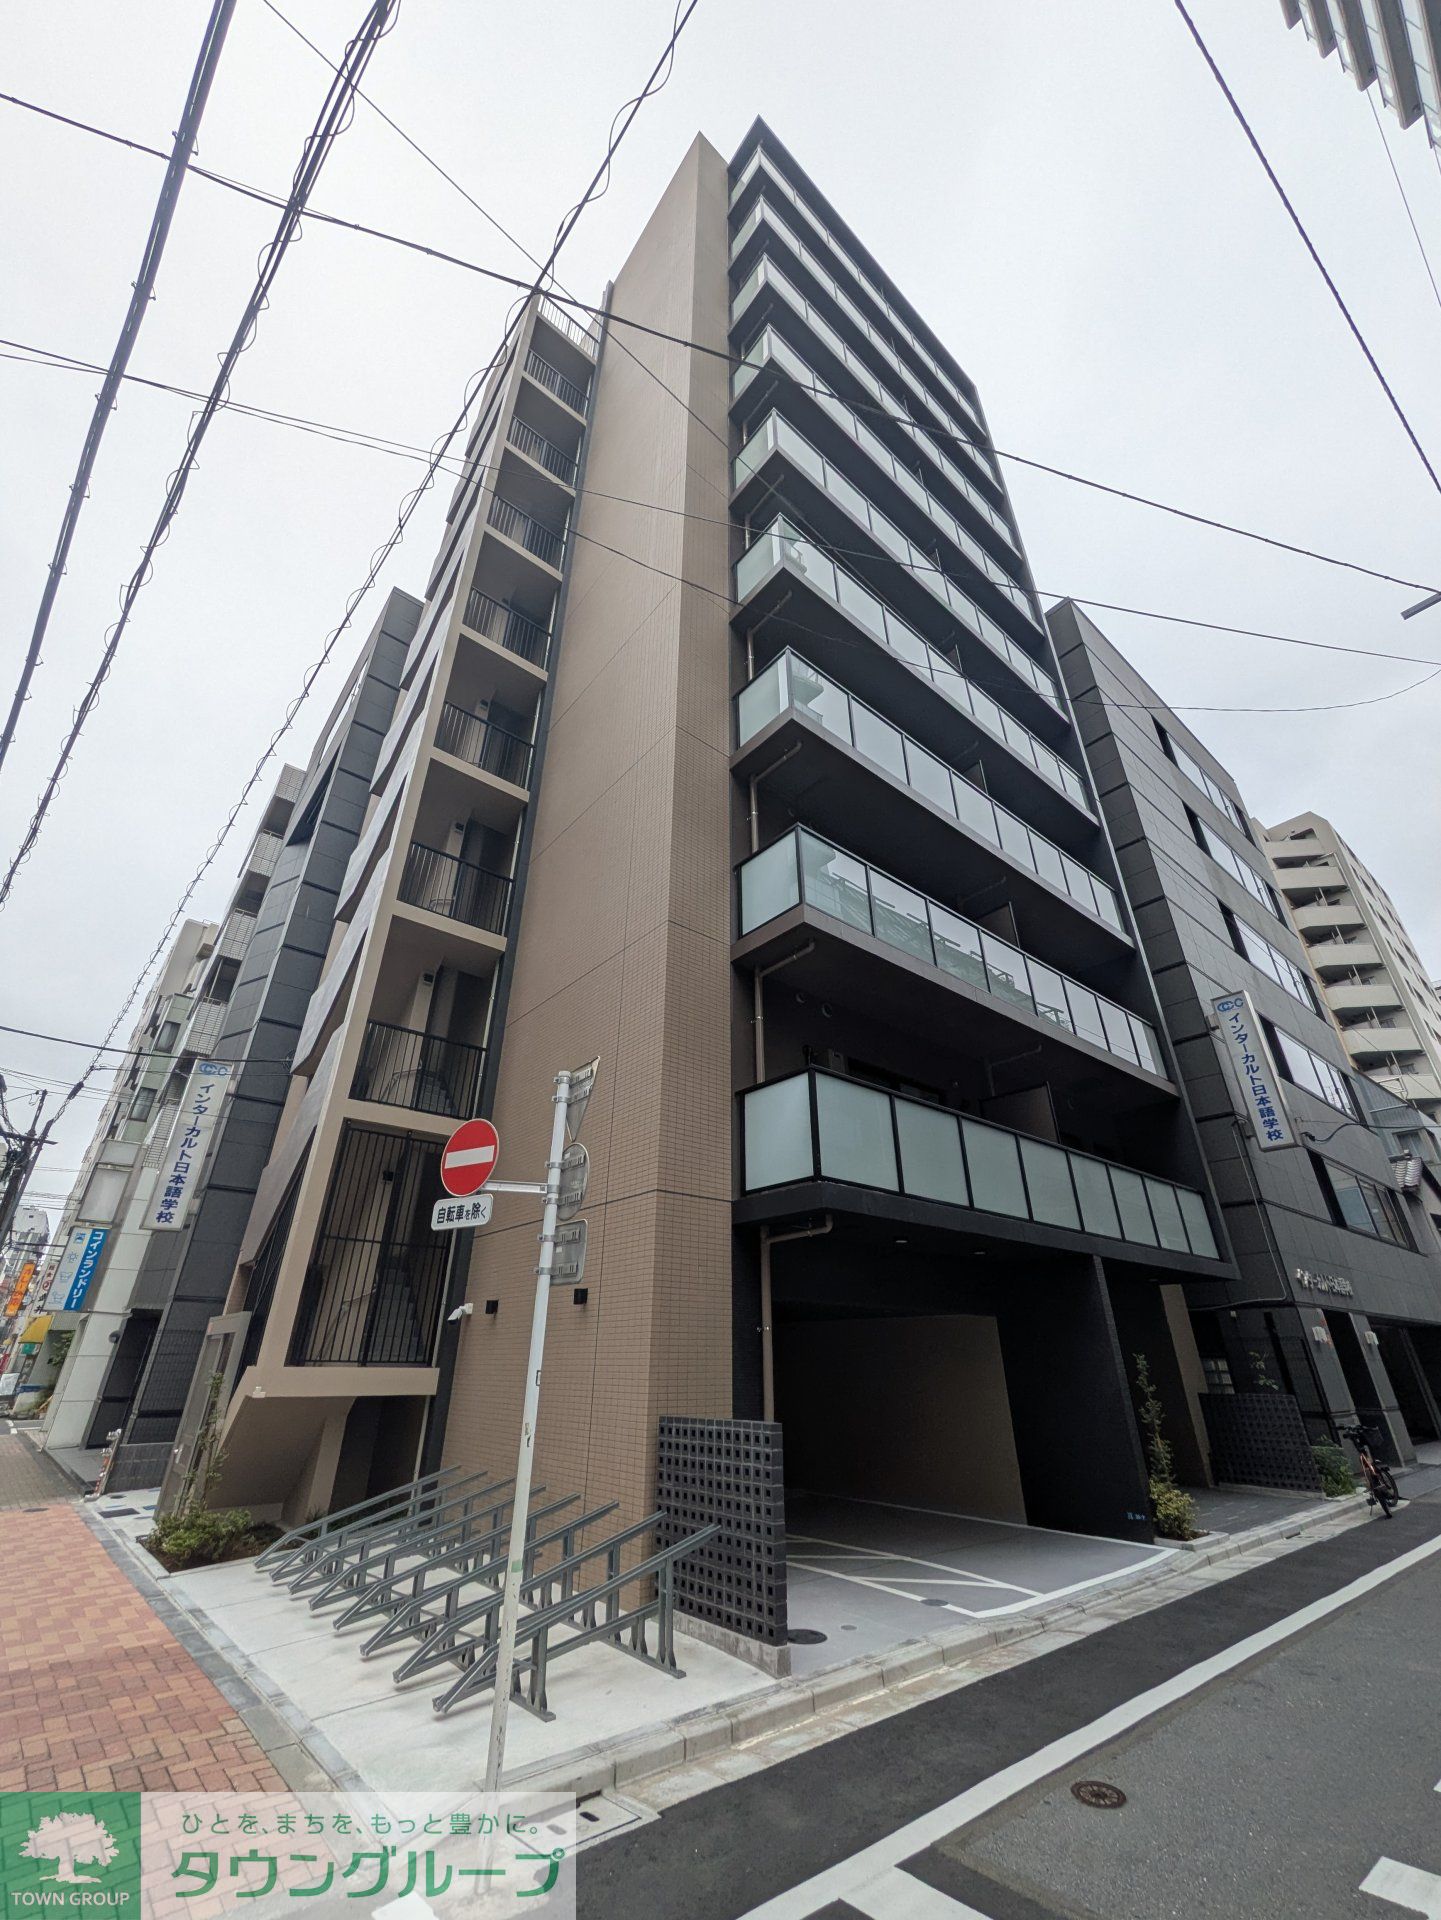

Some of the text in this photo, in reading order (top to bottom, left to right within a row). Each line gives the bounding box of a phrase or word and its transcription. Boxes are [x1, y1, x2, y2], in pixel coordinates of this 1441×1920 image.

[1229, 1012, 1284, 1142] インターカルト日本語学校
[155, 1083, 215, 1224] インターカルト日本語学校
[437, 1202, 487, 1224] 自転車を除く
[70, 1231, 104, 1309] コインランドリー
